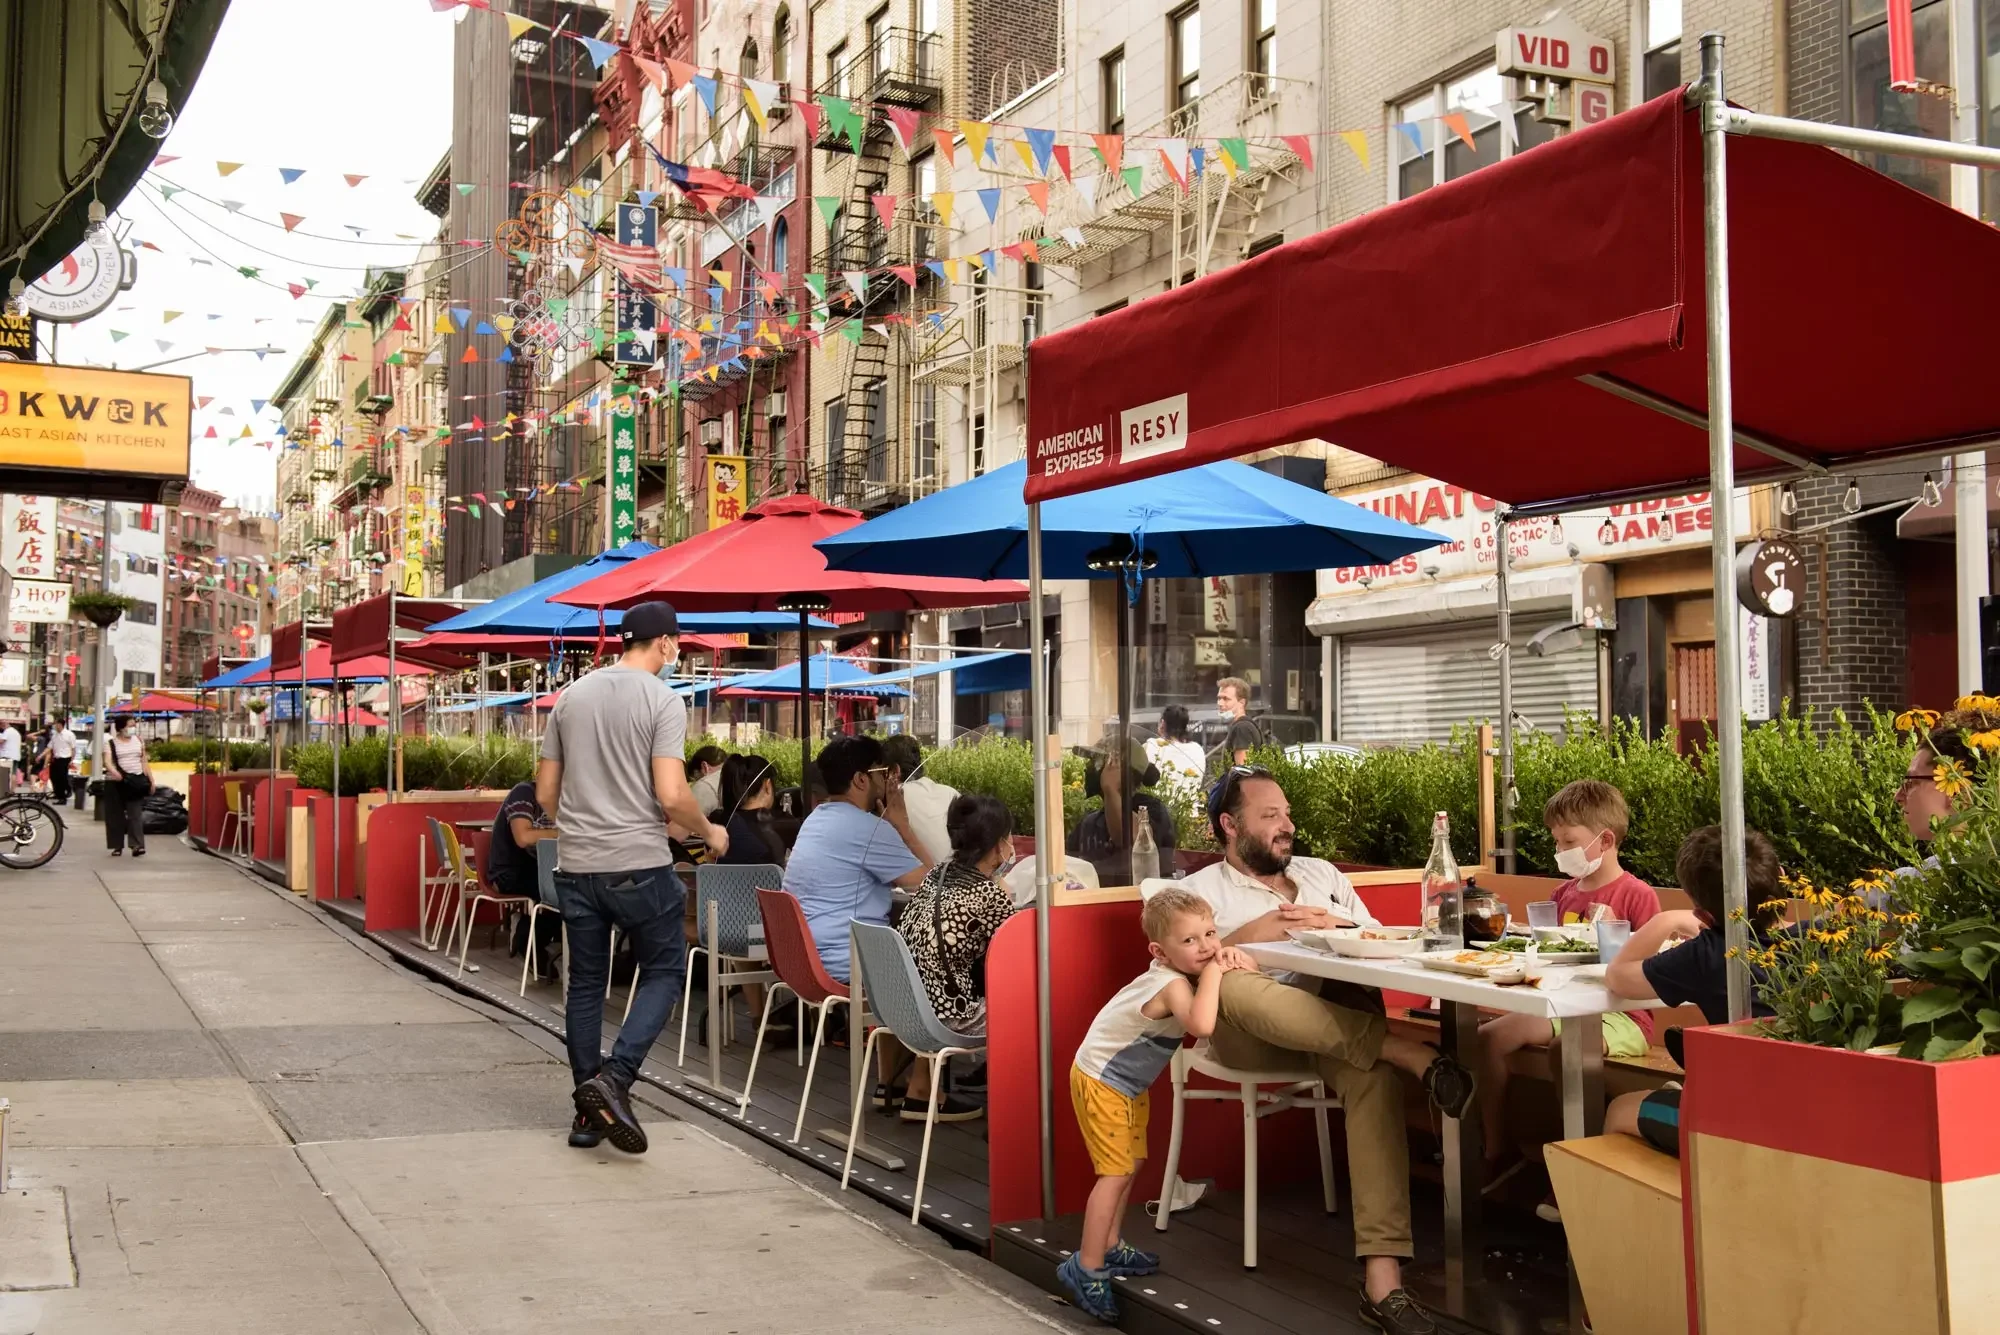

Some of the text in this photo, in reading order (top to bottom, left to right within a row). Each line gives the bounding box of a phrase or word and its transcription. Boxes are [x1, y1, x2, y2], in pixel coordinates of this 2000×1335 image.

[1581, 90, 1607, 124] G
[25, 251, 116, 311] ST ASIAN KITCHEN
[38, 430, 88, 442] ASIAN
[96, 433, 166, 448] KITCHEN
[1036, 423, 1103, 459] AMERICAN
[1130, 411, 1180, 446] RESY
[1045, 445, 1104, 477] EXPRESS
[1598, 507, 1713, 543] GAMES
[1335, 554, 1418, 584] GAMES
[28, 588, 66, 604] HOP
